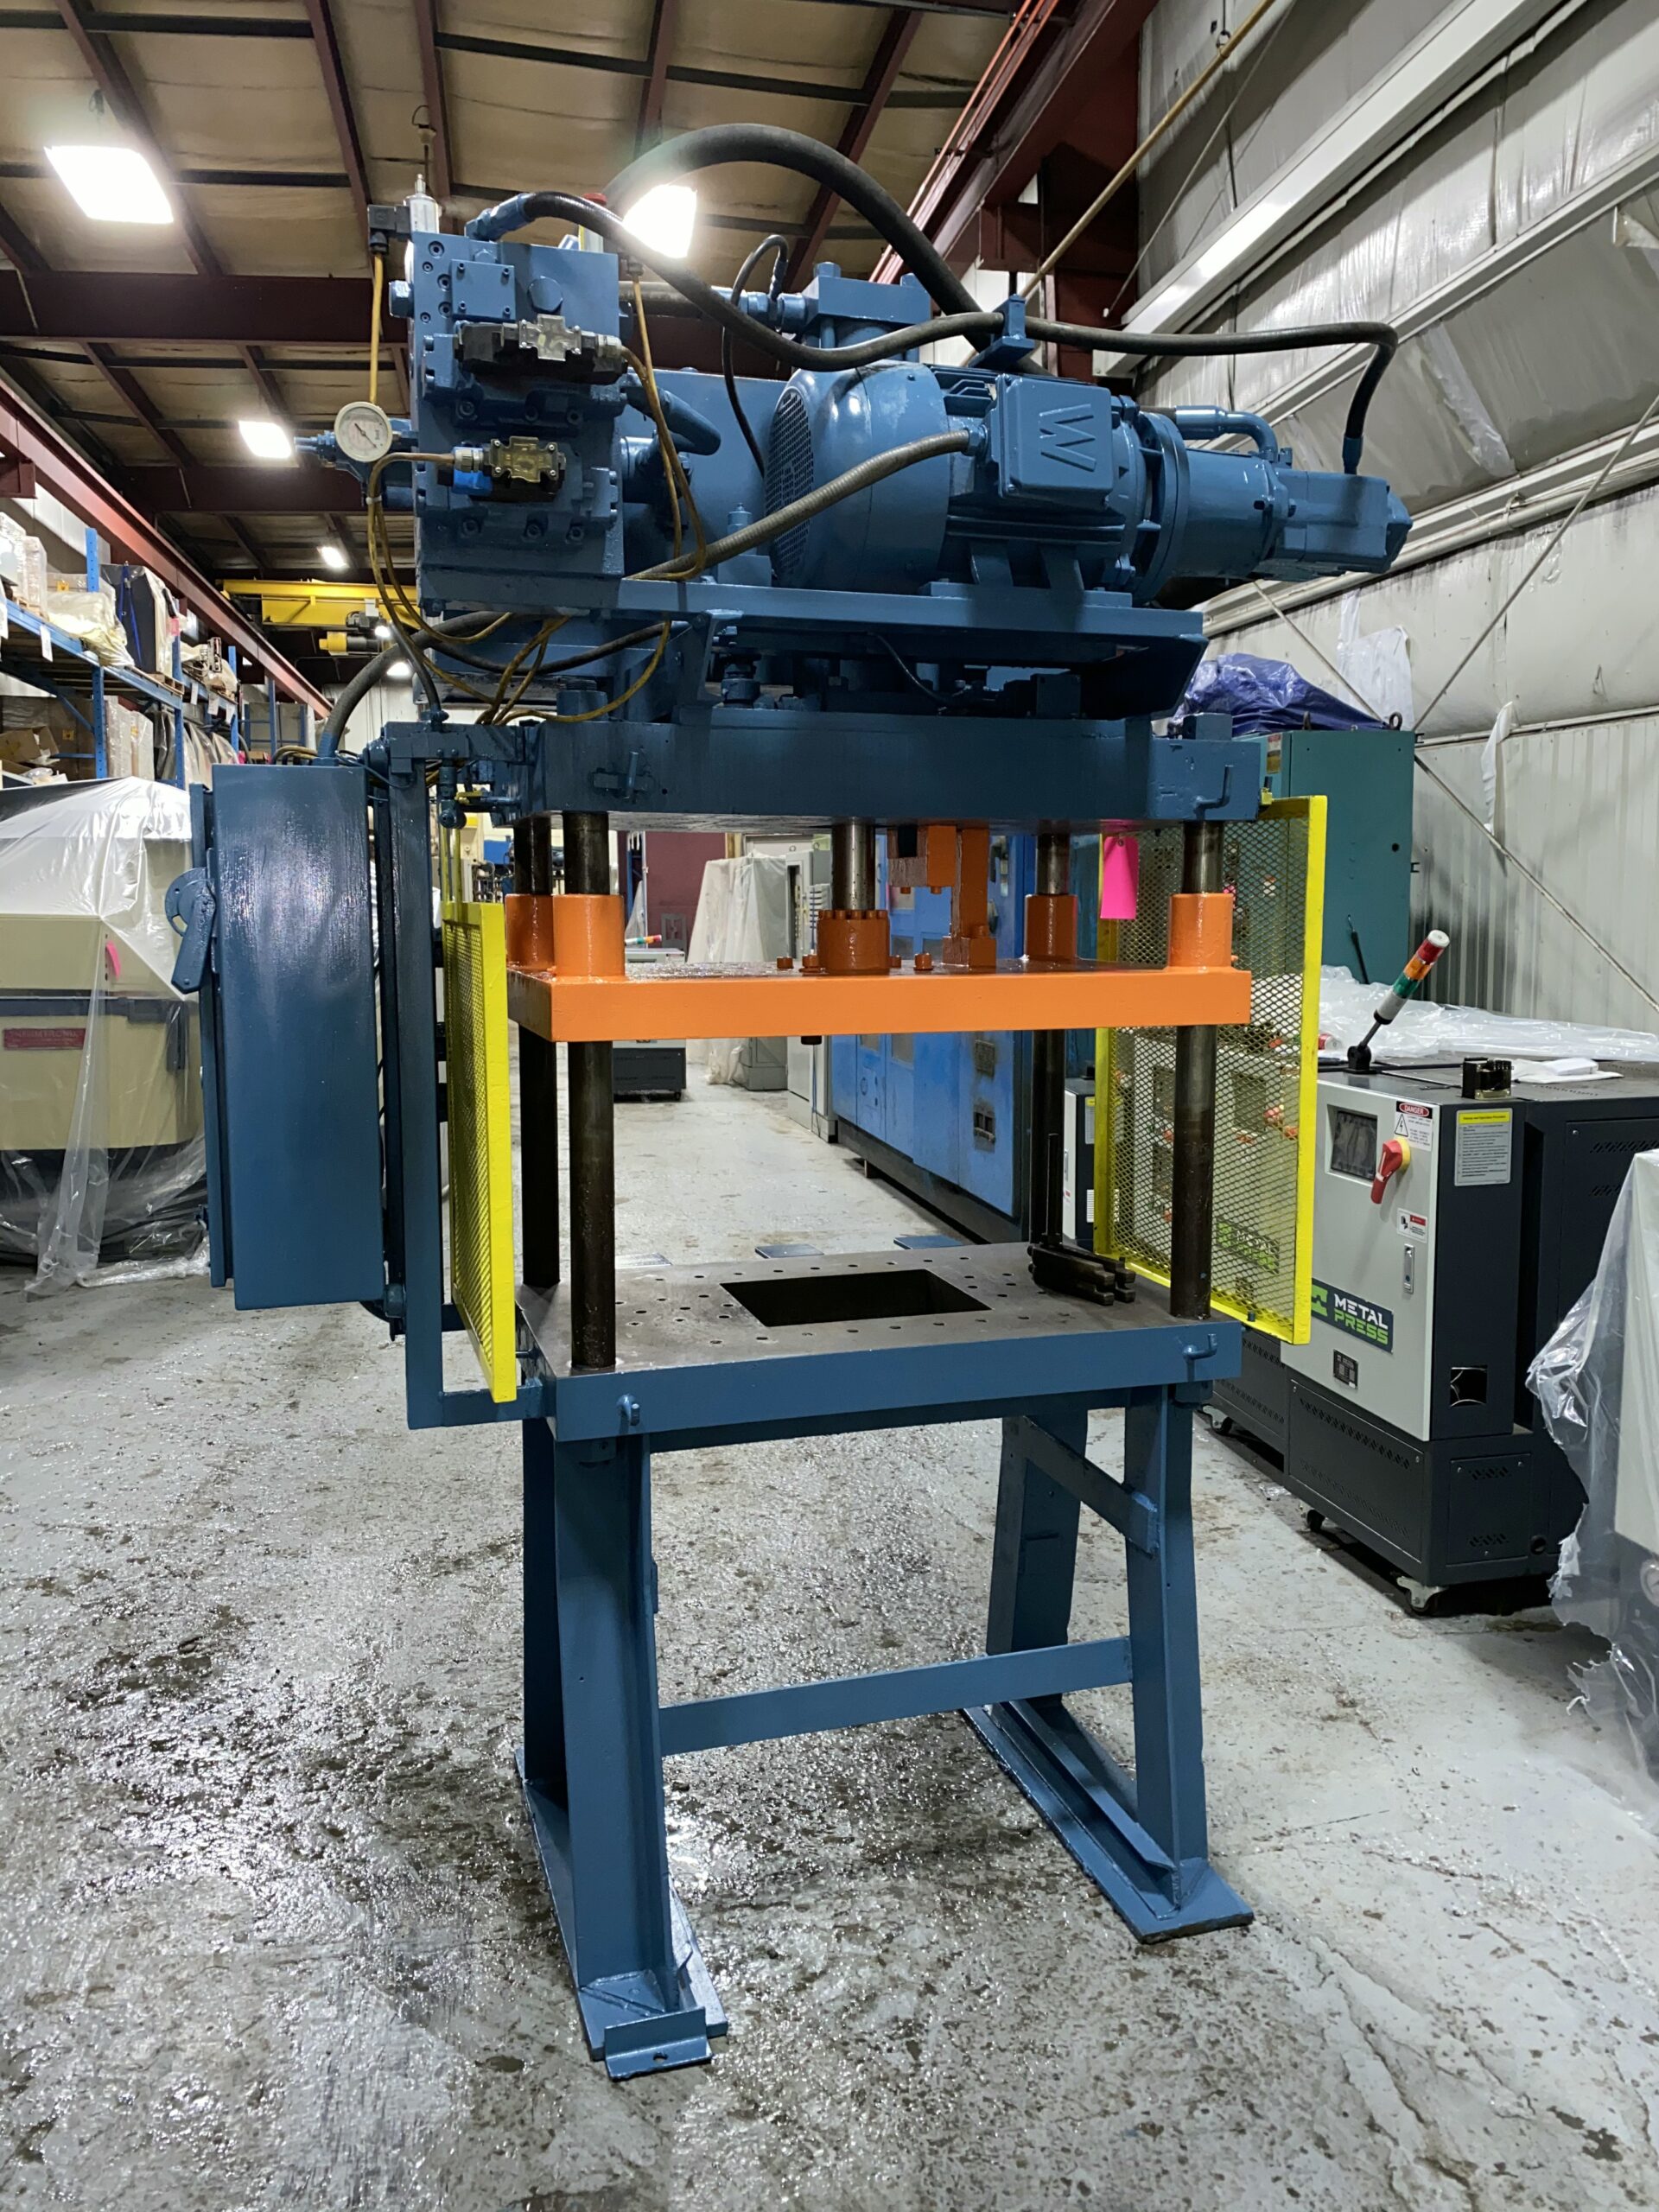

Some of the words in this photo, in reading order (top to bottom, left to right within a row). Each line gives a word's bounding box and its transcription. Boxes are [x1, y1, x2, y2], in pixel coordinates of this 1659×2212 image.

[1404, 1104, 1424, 1116] DANGER
[1334, 1294, 1389, 1330] METAL
[1334, 1308, 1389, 1345] PRESS
